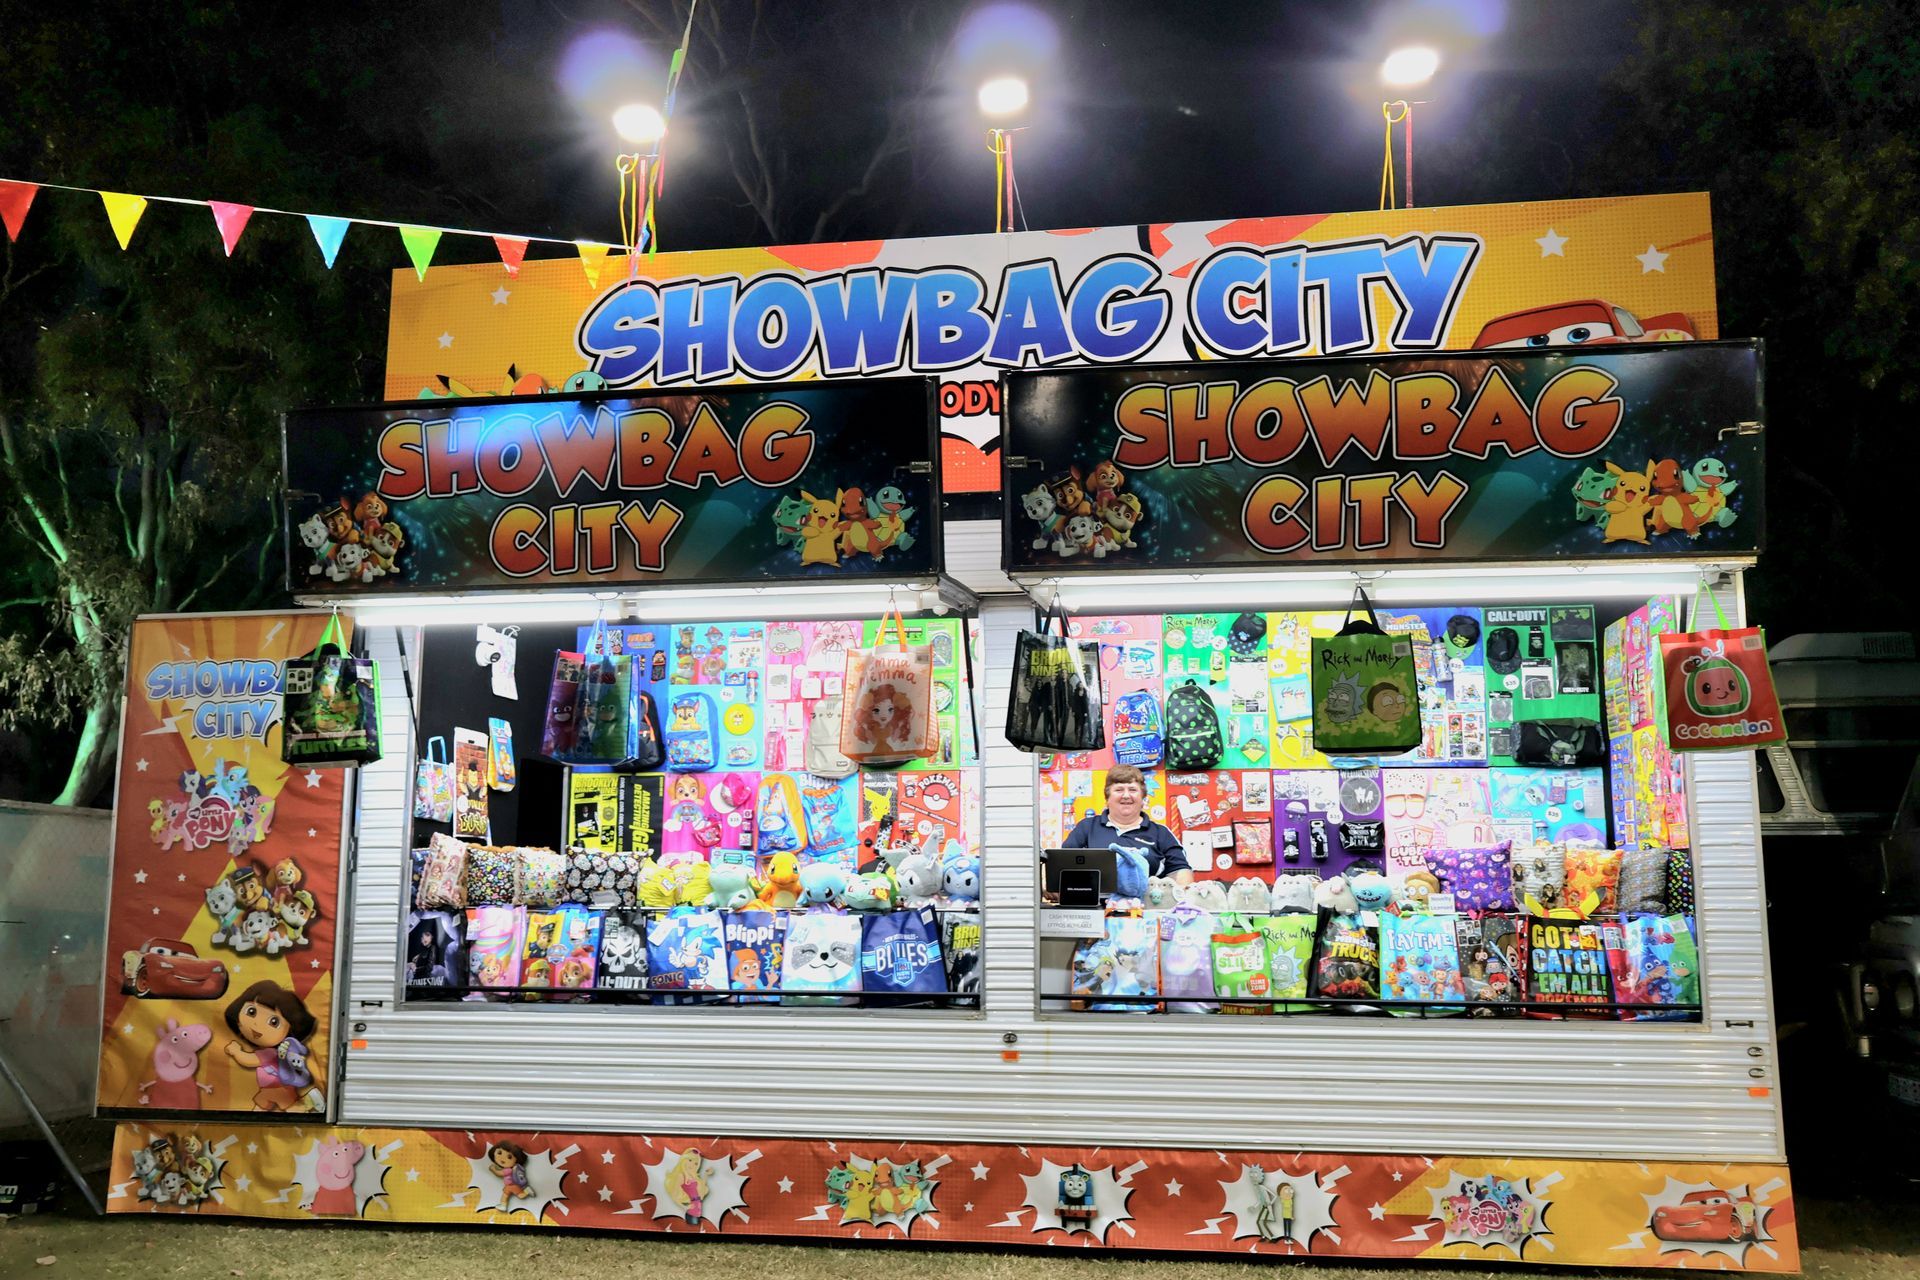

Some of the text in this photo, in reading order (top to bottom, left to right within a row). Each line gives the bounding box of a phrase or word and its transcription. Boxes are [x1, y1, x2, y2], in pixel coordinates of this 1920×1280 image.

[579, 234, 1483, 387] SHOWBAG CITY
[1115, 367, 1623, 470] SHOWBAG
[378, 402, 815, 498] SHOWBAG
[1242, 471, 1468, 554] CITY
[490, 500, 682, 577] CITY
[1321, 648, 1351, 670] Rick
[1366, 646, 1403, 670] Morty
[193, 699, 276, 740] CITY
[185, 811, 236, 846] PONY
[726, 924, 774, 947] Blippi
[1263, 926, 1285, 944] Rick
[875, 943, 928, 972] BLUES
[1532, 948, 1606, 975] CATCH
[615, 976, 648, 988] DUTY
[651, 971, 684, 985] SONIC
[1534, 973, 1608, 996] 'EM ALL!
[1469, 1211, 1507, 1234] PONY
